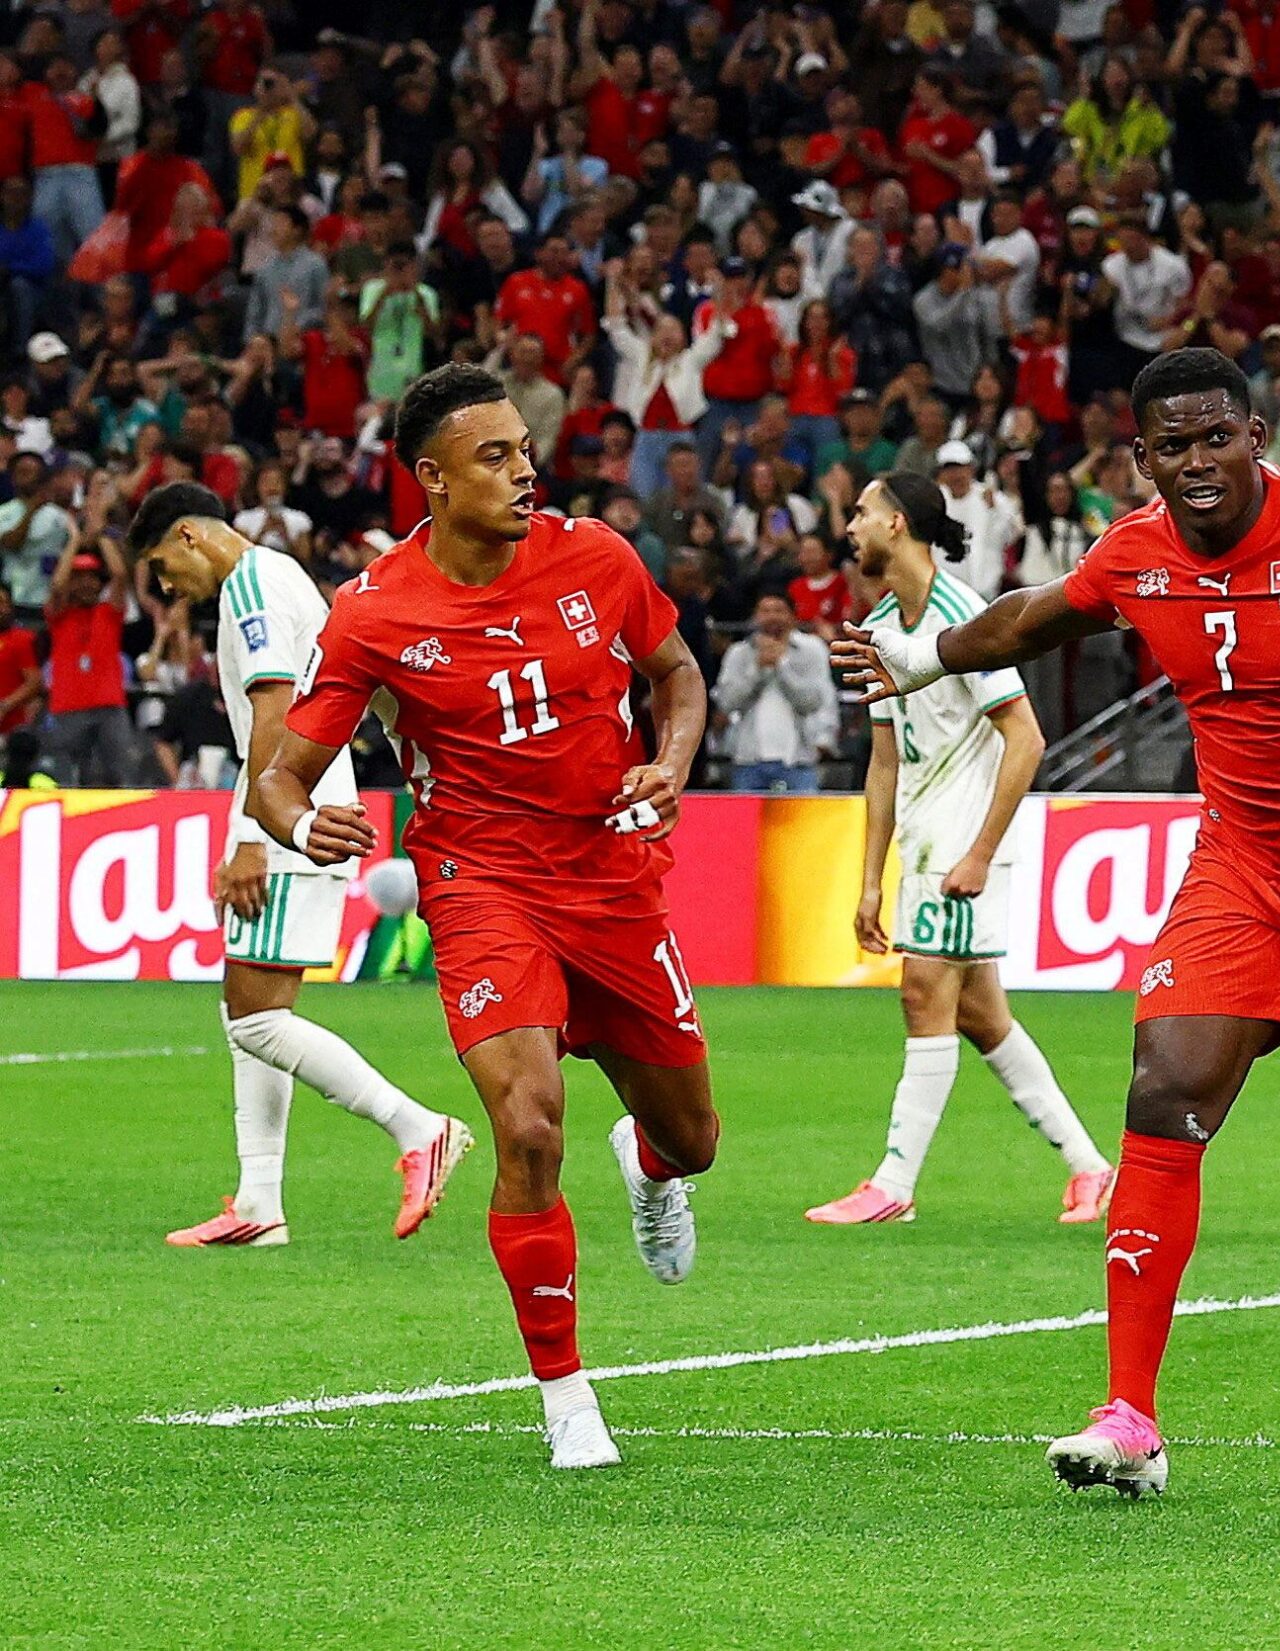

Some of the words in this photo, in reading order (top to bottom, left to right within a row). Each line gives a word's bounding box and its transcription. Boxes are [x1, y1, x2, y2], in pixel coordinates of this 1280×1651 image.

[1204, 610, 1237, 691] 7
[486, 659, 560, 745] 11
[903, 722, 921, 763] 6
[913, 901, 939, 944] 6
